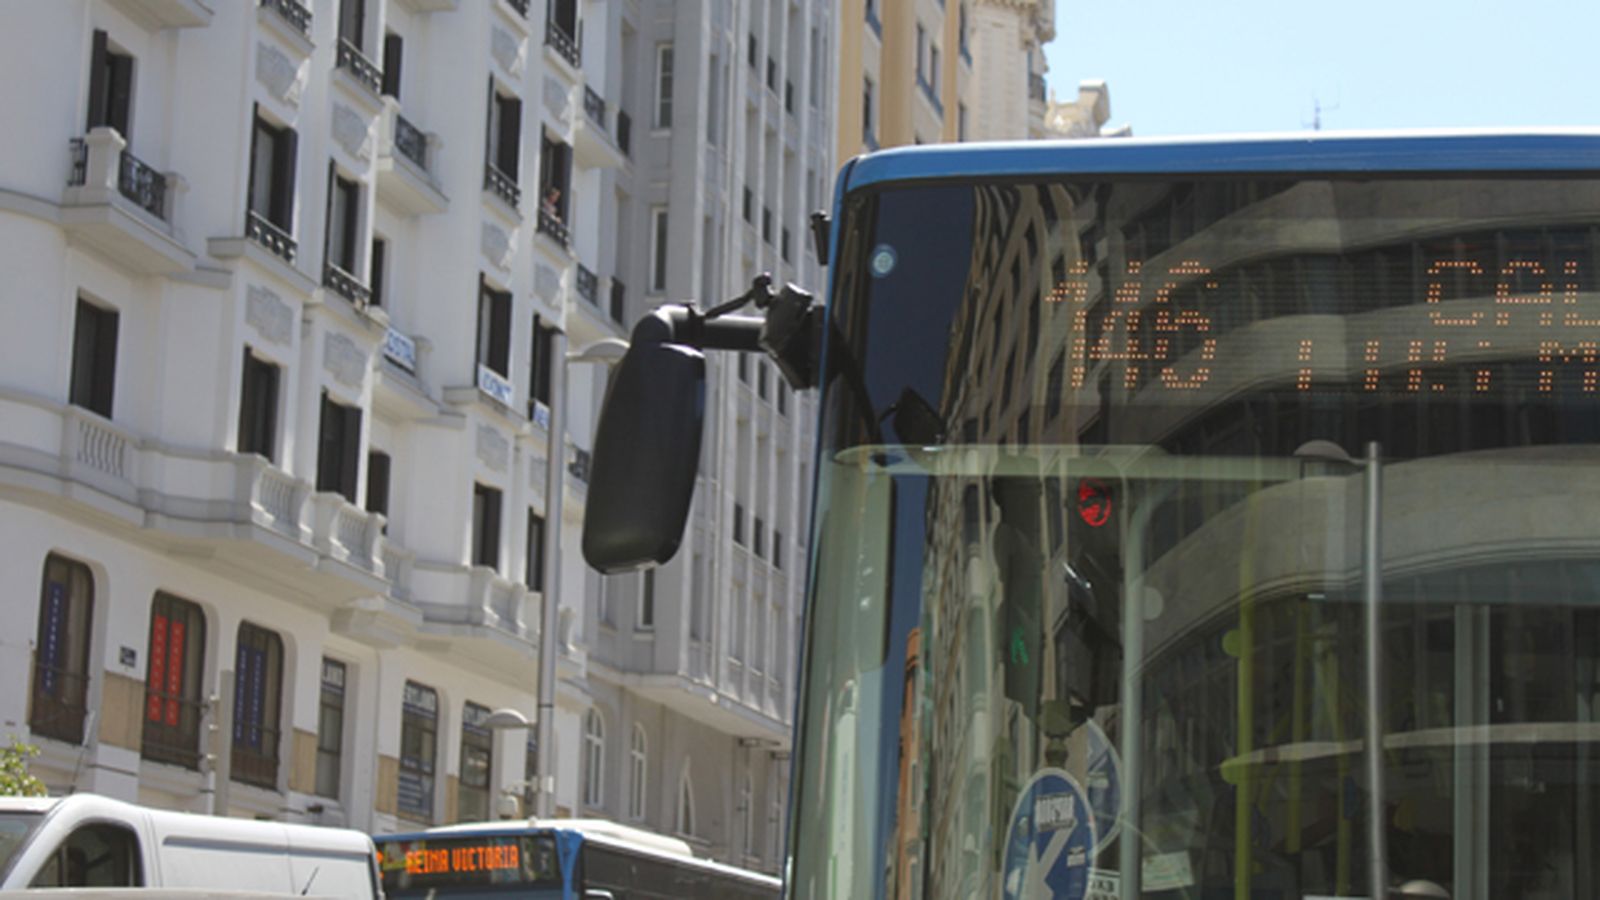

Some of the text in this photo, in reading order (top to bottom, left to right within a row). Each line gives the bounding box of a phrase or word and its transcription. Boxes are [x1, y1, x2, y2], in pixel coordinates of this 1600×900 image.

[1045, 260, 1217, 389] 146
[405, 844, 520, 875] REINA VICTORIA
